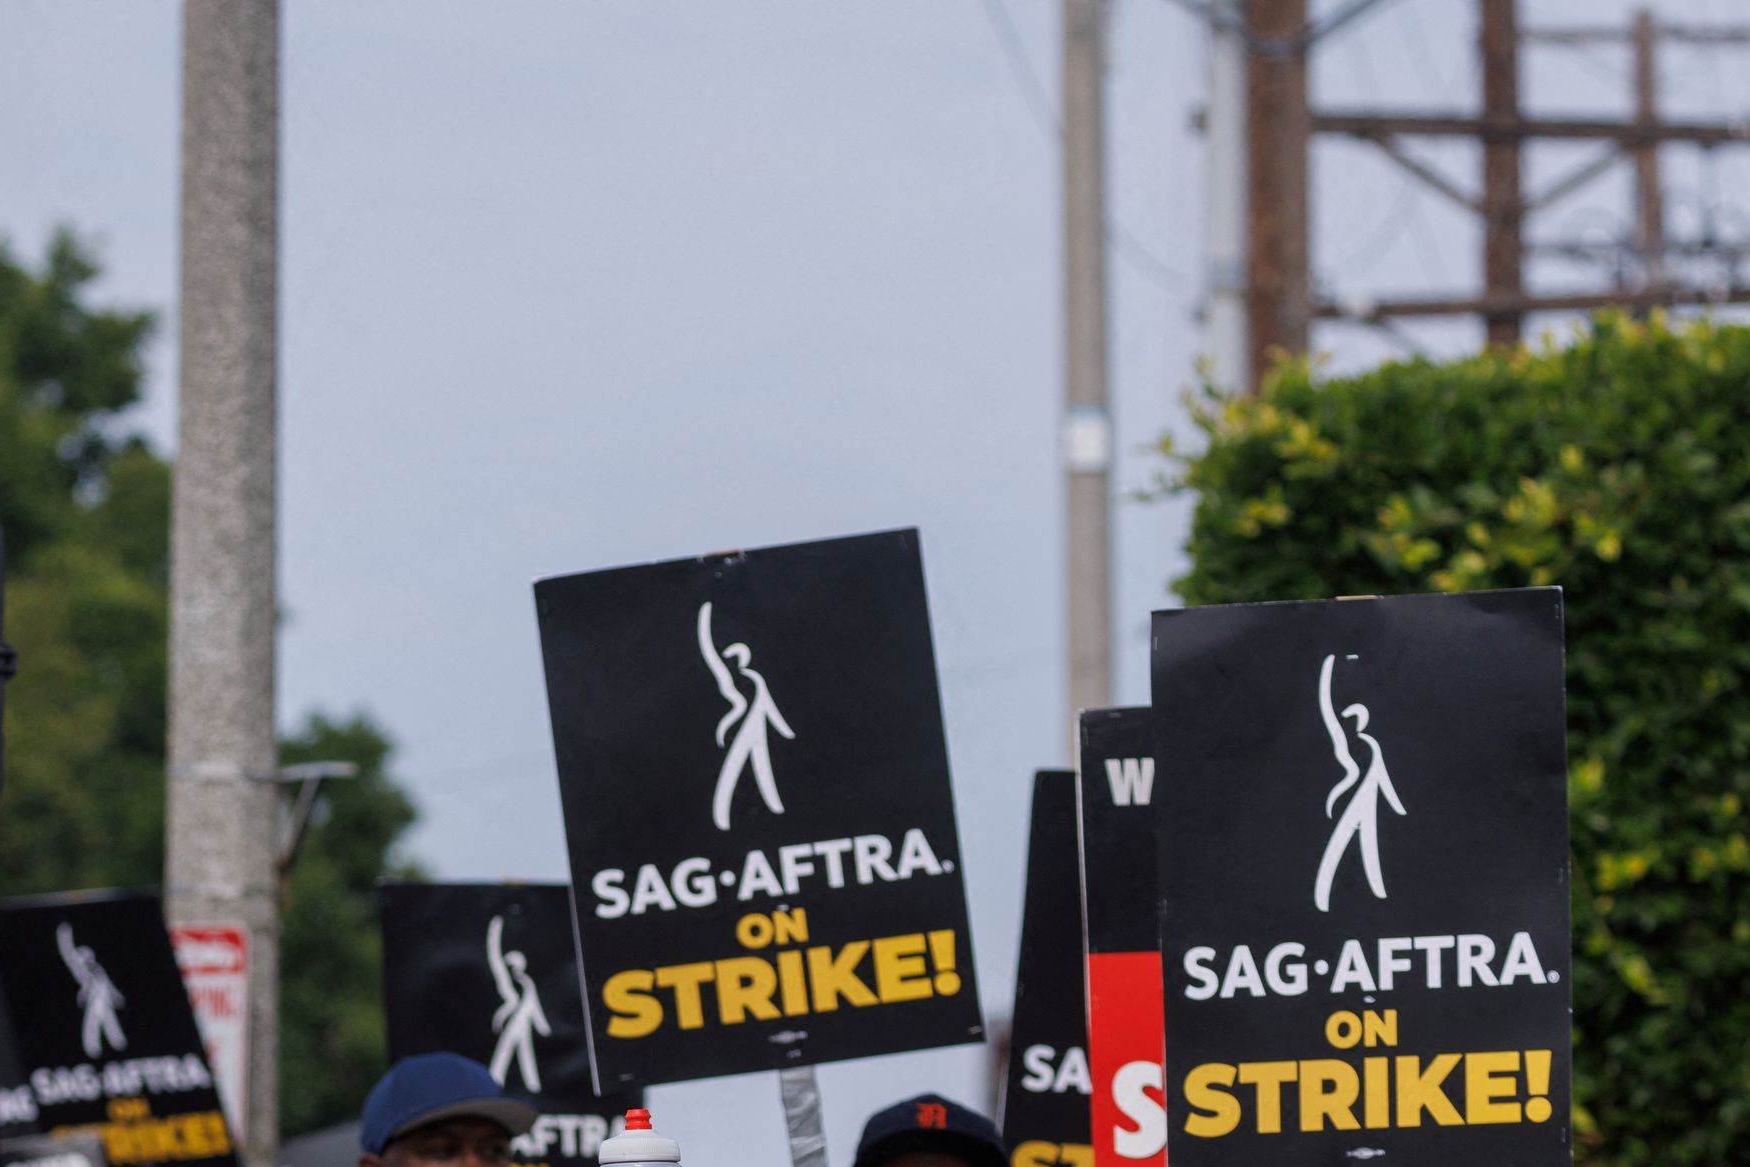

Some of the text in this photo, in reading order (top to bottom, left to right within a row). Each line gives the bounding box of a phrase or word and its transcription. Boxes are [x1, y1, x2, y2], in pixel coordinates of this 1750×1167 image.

[736, 907, 808, 949] ON
[602, 929, 961, 1038] STRIKE!
[1325, 1009, 1398, 1049] ON
[1183, 1049, 1553, 1138] STRIKE!
